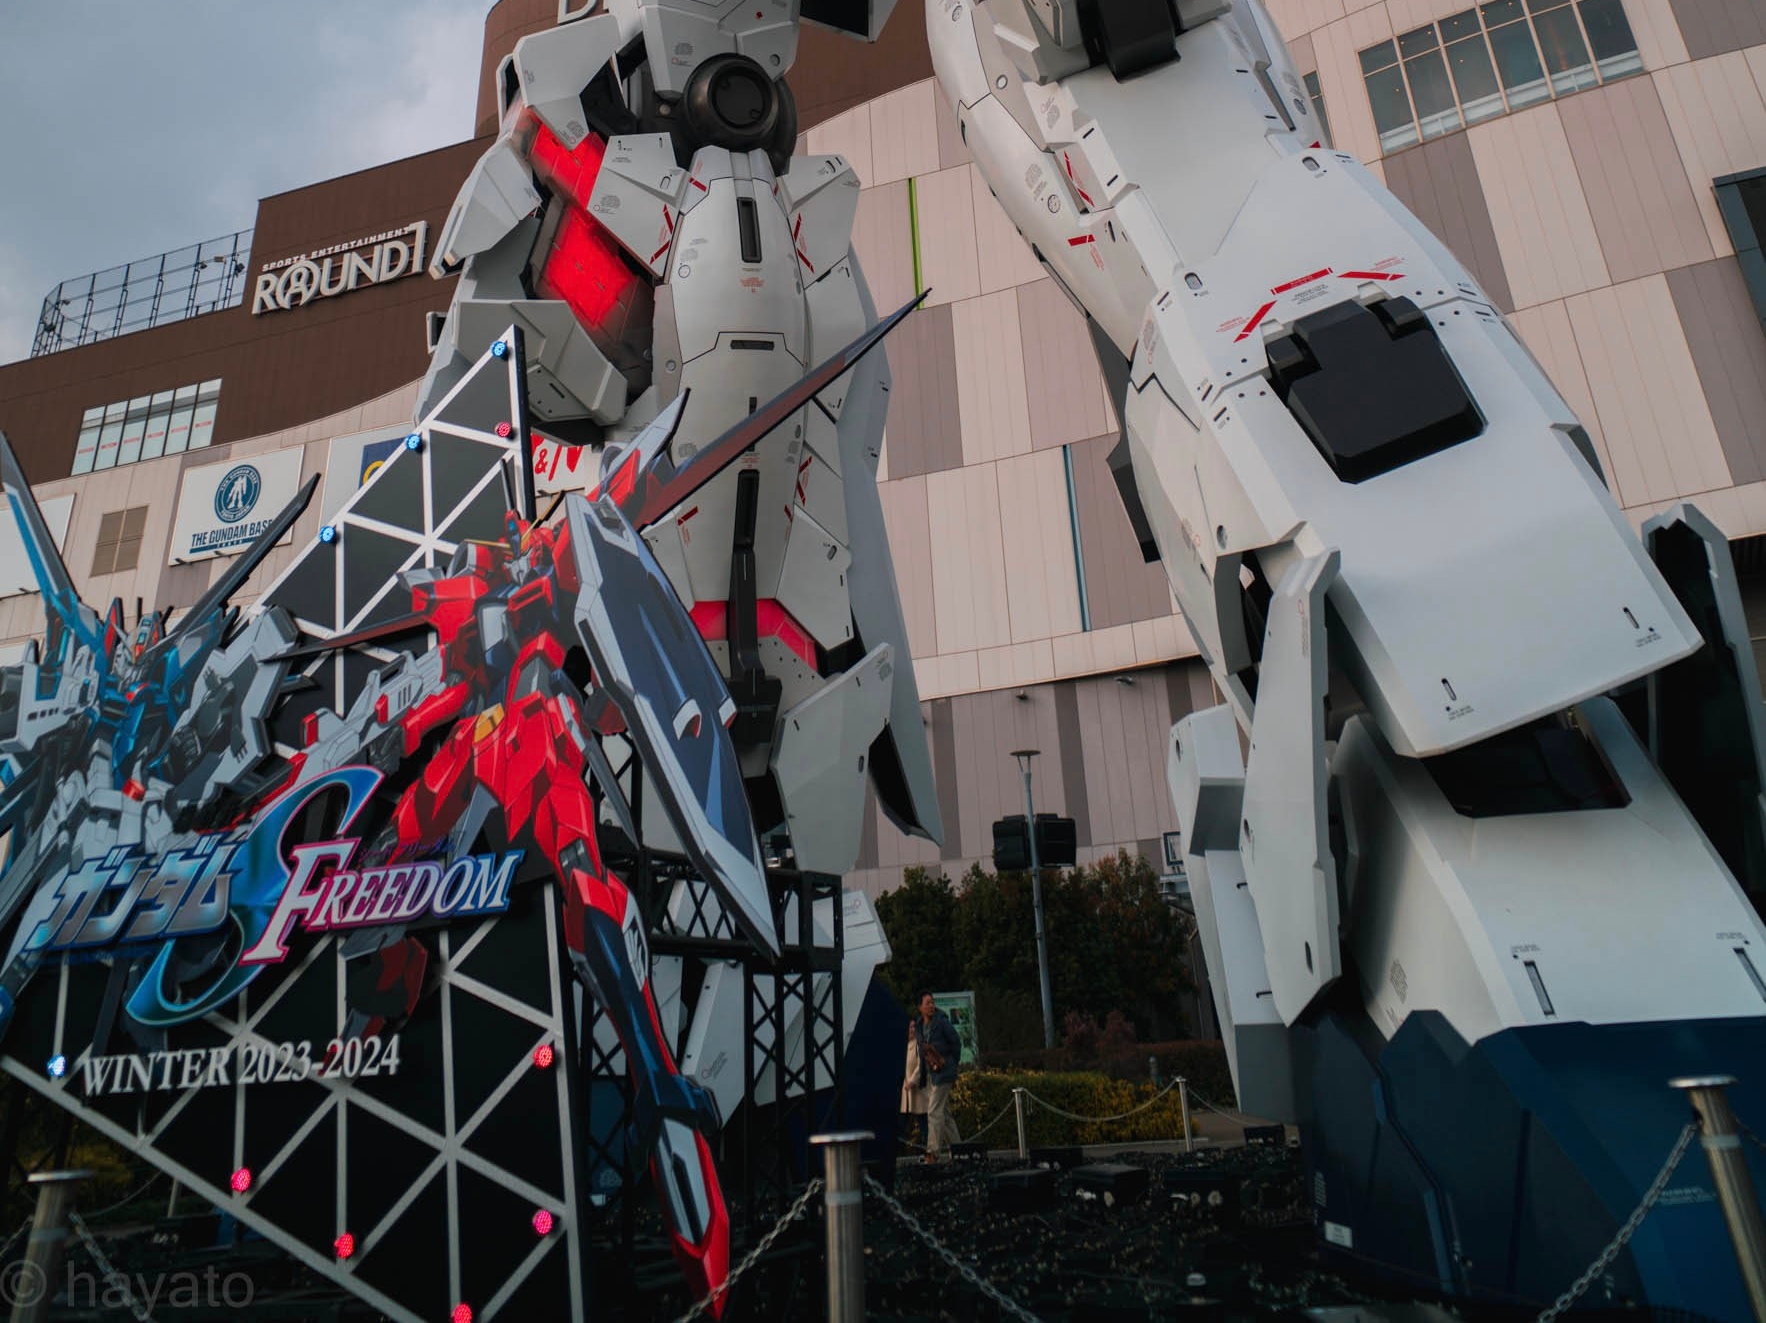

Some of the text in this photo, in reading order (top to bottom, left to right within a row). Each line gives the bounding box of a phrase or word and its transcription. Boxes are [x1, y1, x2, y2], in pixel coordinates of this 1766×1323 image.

[262, 226, 410, 272] SPORTS ENTERTAINMENT
[191, 532, 209, 547] THE
[209, 524, 248, 543] GUNDAM
[21, 833, 239, 952] ガンダム
[239, 838, 523, 964] FREEDOM
[81, 1033, 400, 1097] WINTER 2023-2024
